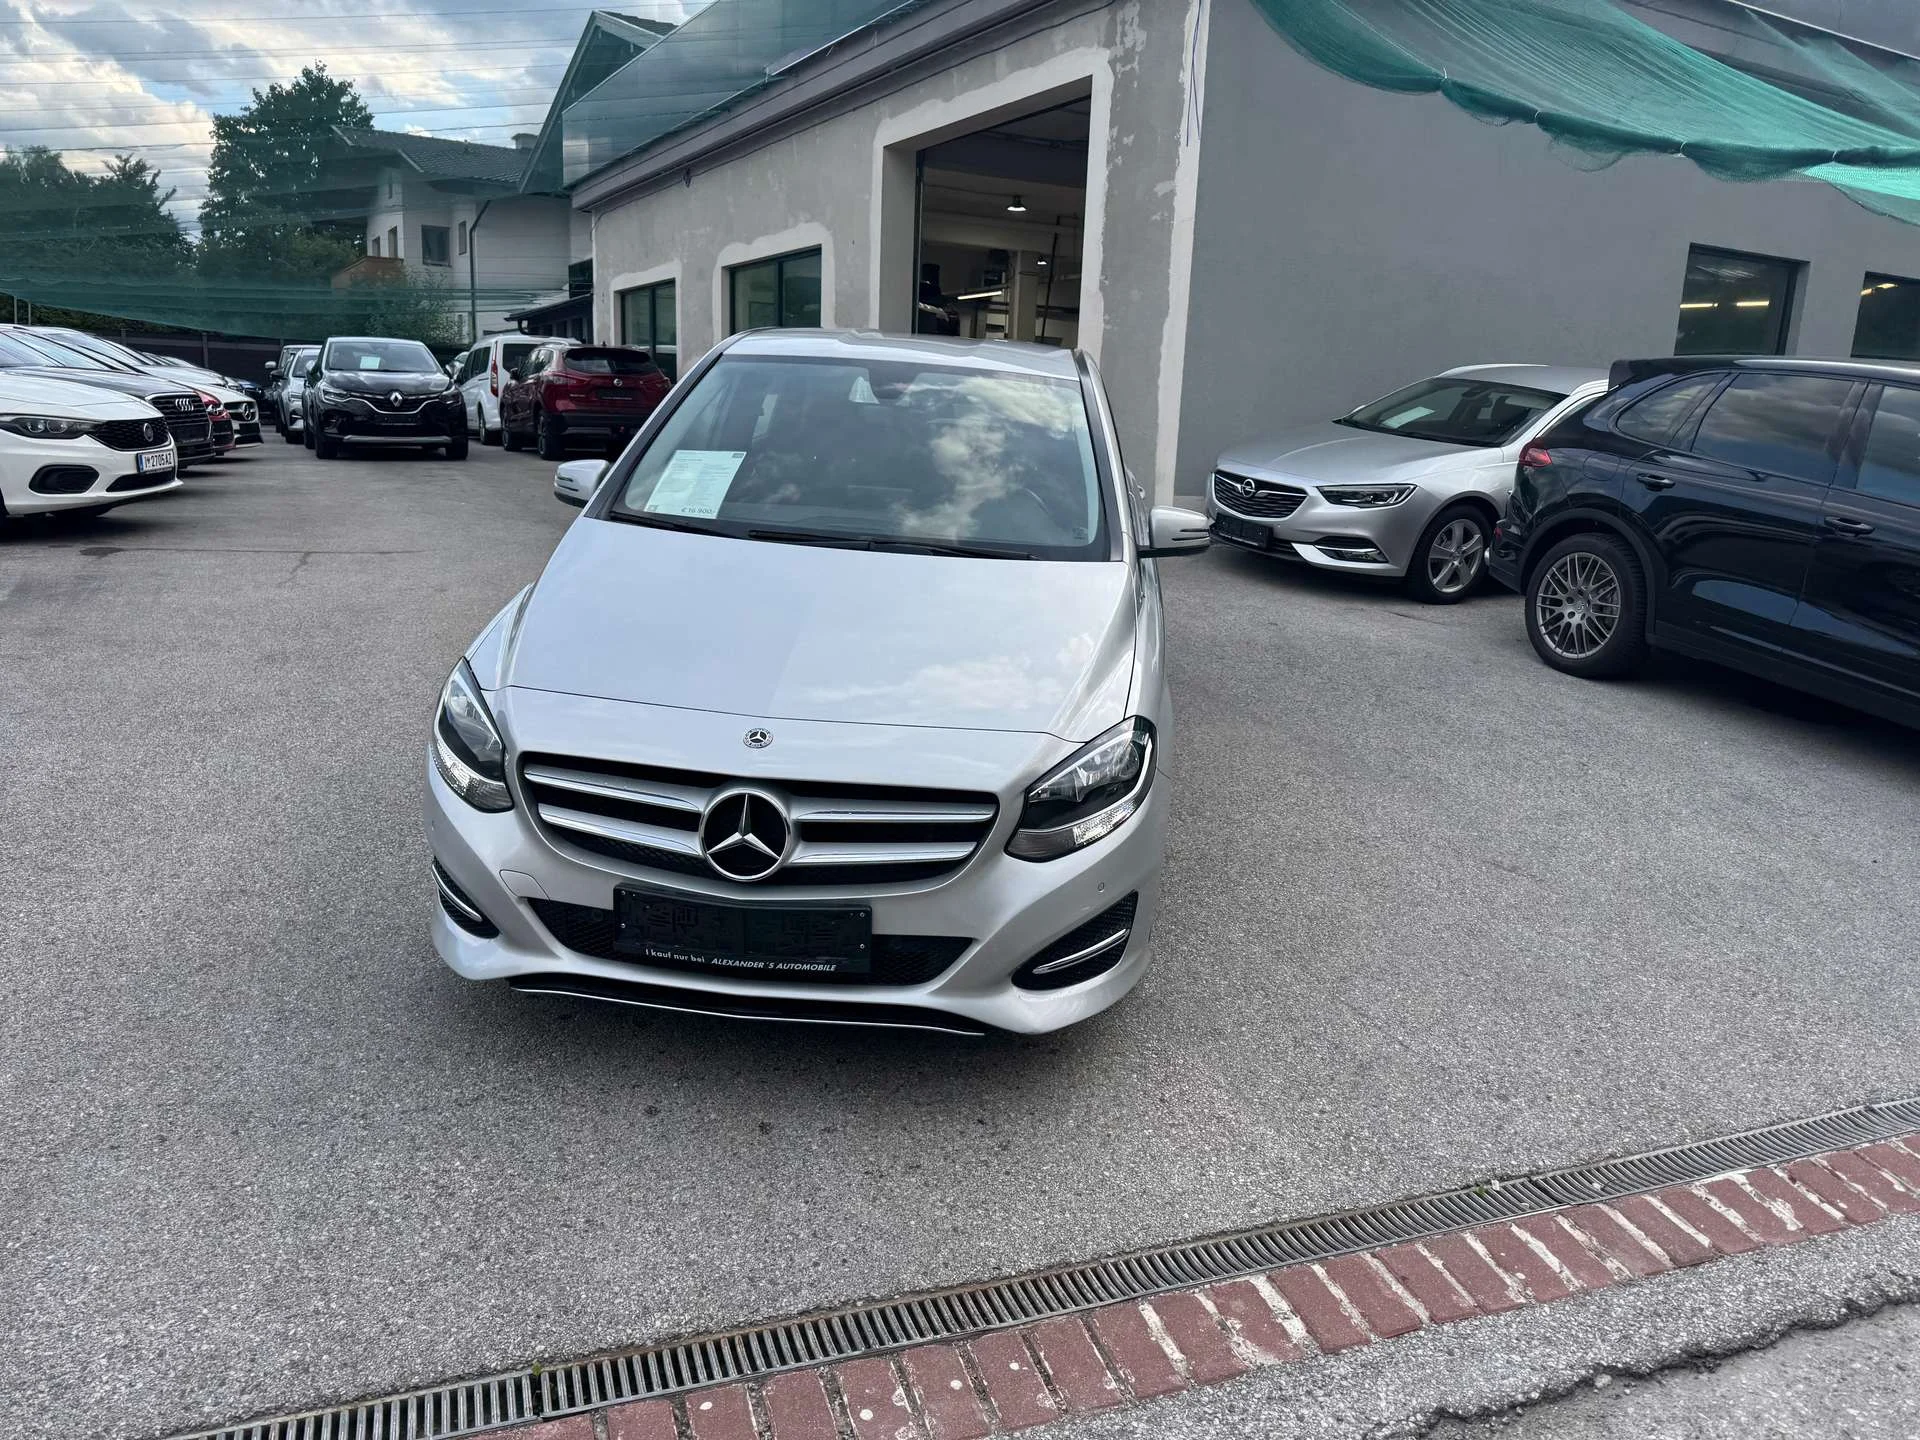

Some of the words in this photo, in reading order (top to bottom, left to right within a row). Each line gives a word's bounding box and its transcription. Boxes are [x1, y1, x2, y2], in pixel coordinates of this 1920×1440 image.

[650, 949, 671, 959] kauf
[690, 954, 705, 963] bei
[776, 963, 837, 972] AUTOMOBILE
